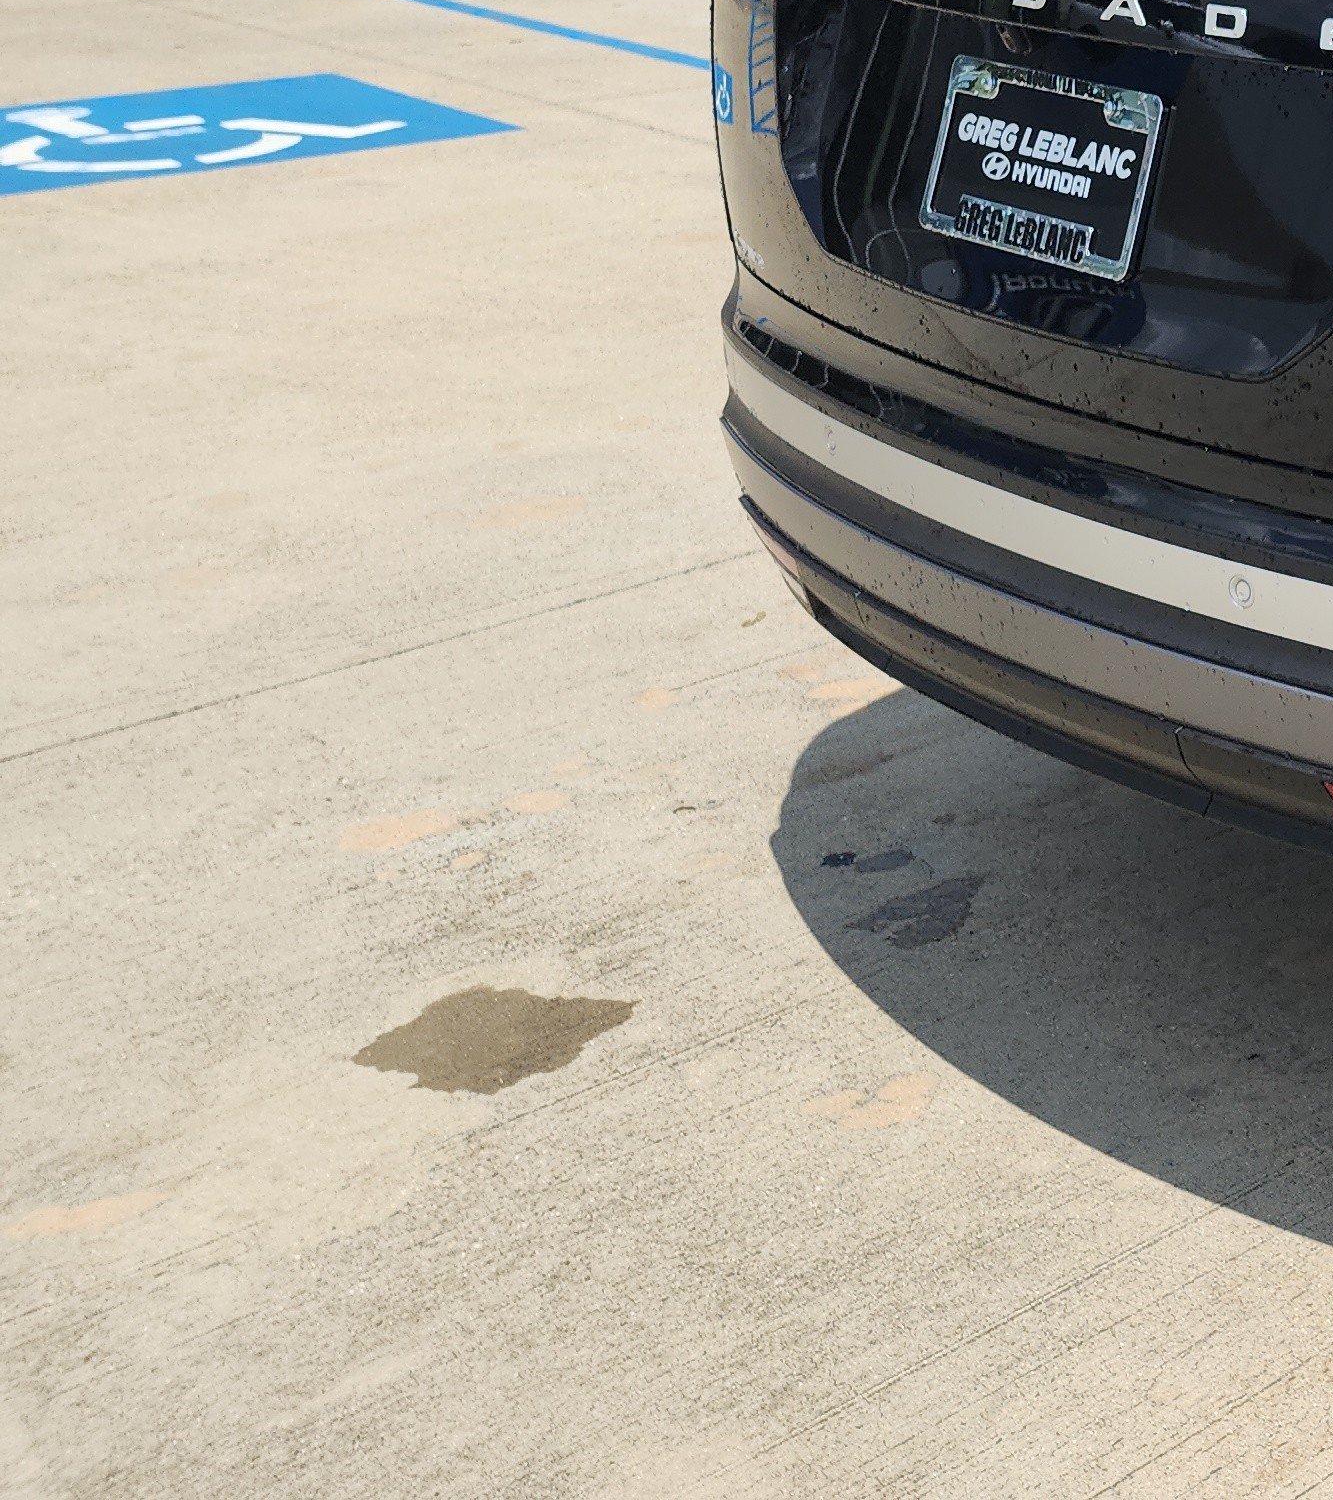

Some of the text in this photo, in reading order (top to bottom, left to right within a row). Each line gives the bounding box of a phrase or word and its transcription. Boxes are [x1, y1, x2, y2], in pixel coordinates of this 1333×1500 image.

[958, 113, 1137, 180] GREG LEBLANC
[1011, 160, 1092, 199] HYUNDAI
[954, 200, 1005, 243] GREG
